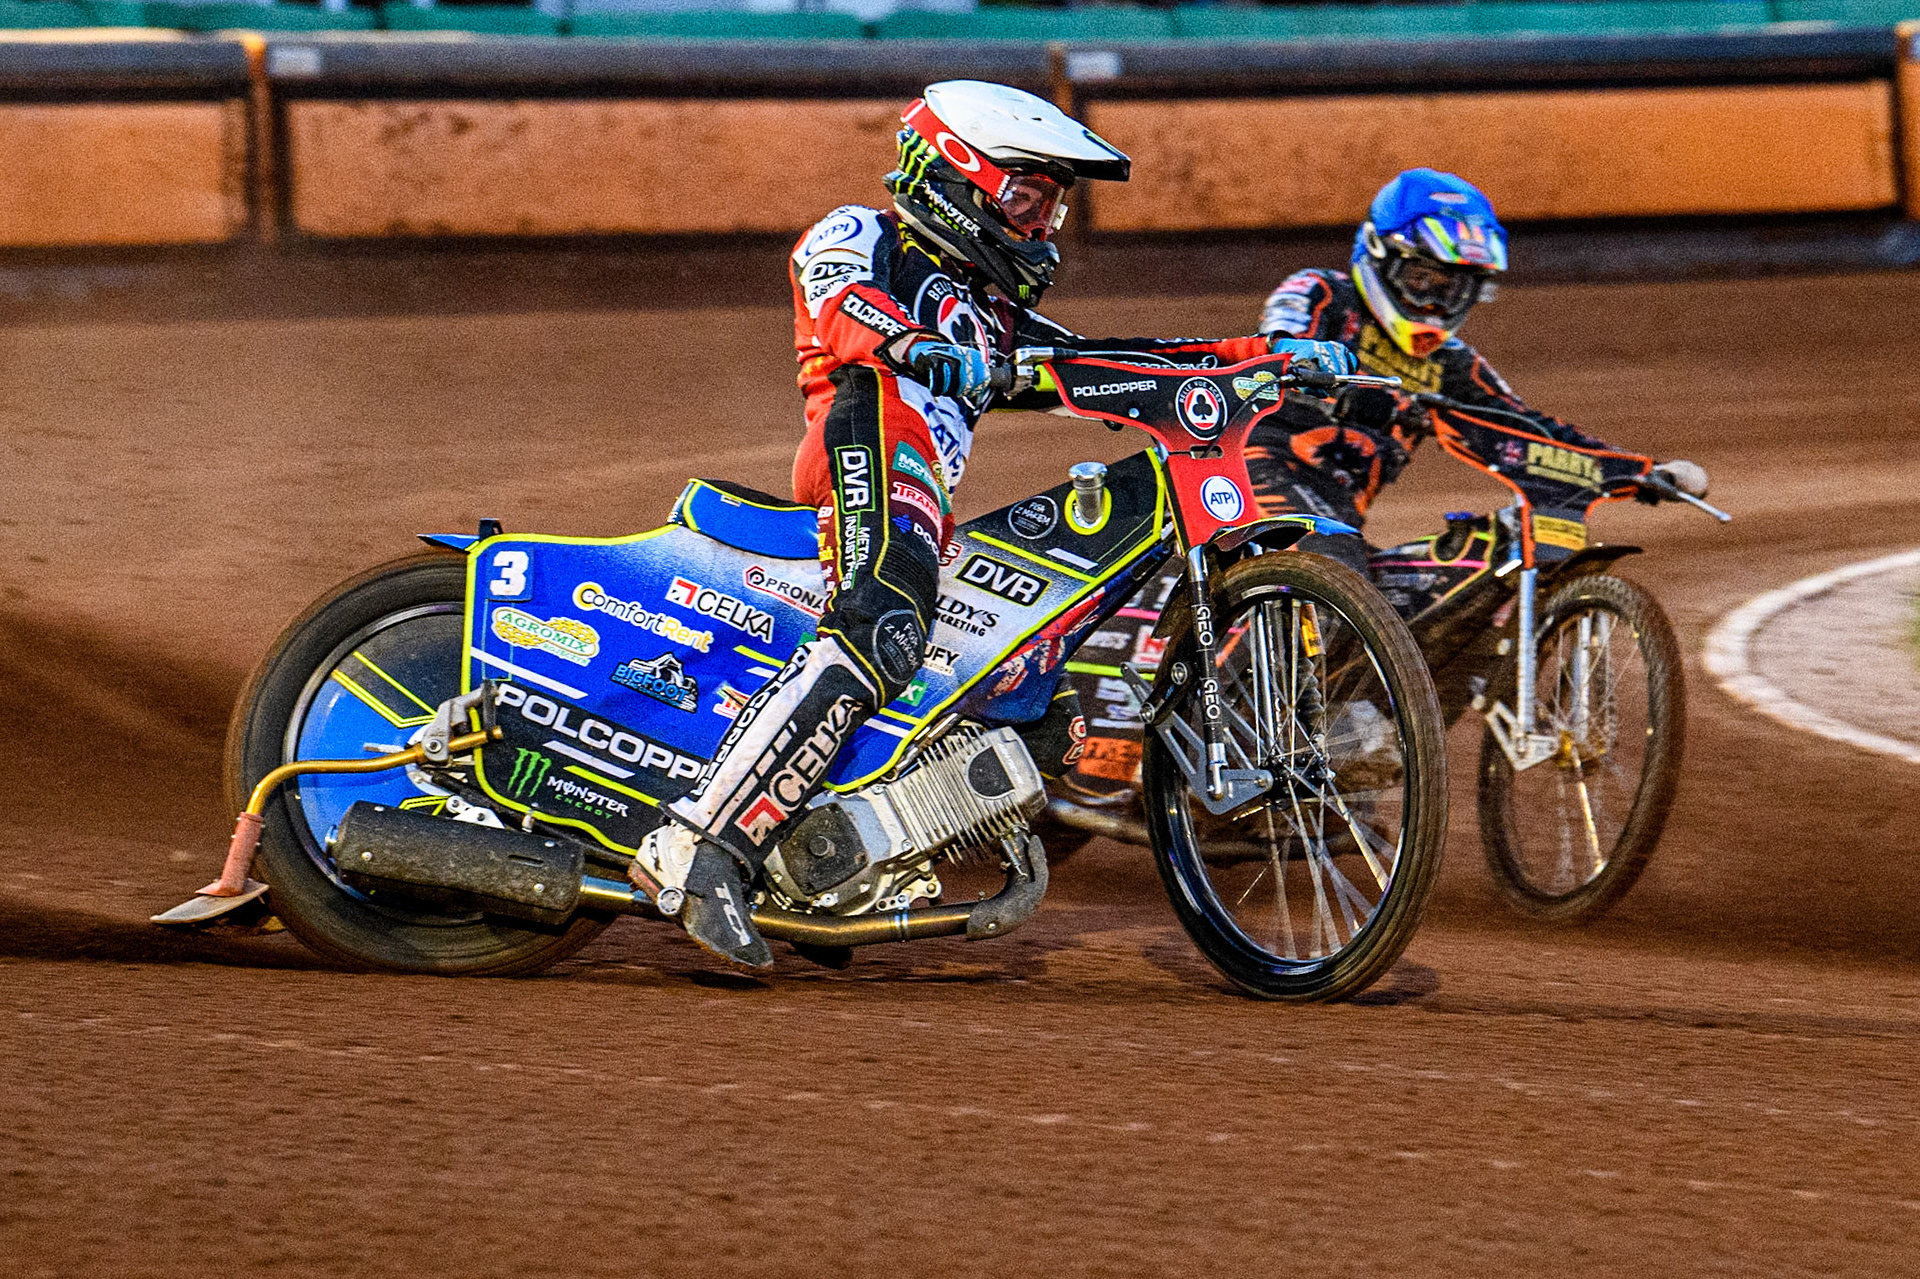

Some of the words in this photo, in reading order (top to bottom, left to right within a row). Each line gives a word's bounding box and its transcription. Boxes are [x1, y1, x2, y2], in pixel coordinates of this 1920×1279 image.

[1073, 379, 1158, 399] POLCOPPER
[841, 450, 870, 509] DVR
[1210, 490, 1235, 507] ATPI
[855, 526, 871, 570] METAL
[489, 550, 530, 596] 3
[963, 558, 1041, 603] DVR
[502, 613, 588, 653] AGROMIX
[577, 583, 713, 651] ComfortRent
[696, 591, 773, 641] CELKA
[936, 595, 1001, 628] LDY'S
[615, 664, 688, 702] BIGFOOT
[495, 682, 708, 782] POLCOPP
[772, 697, 866, 809] CELKA
